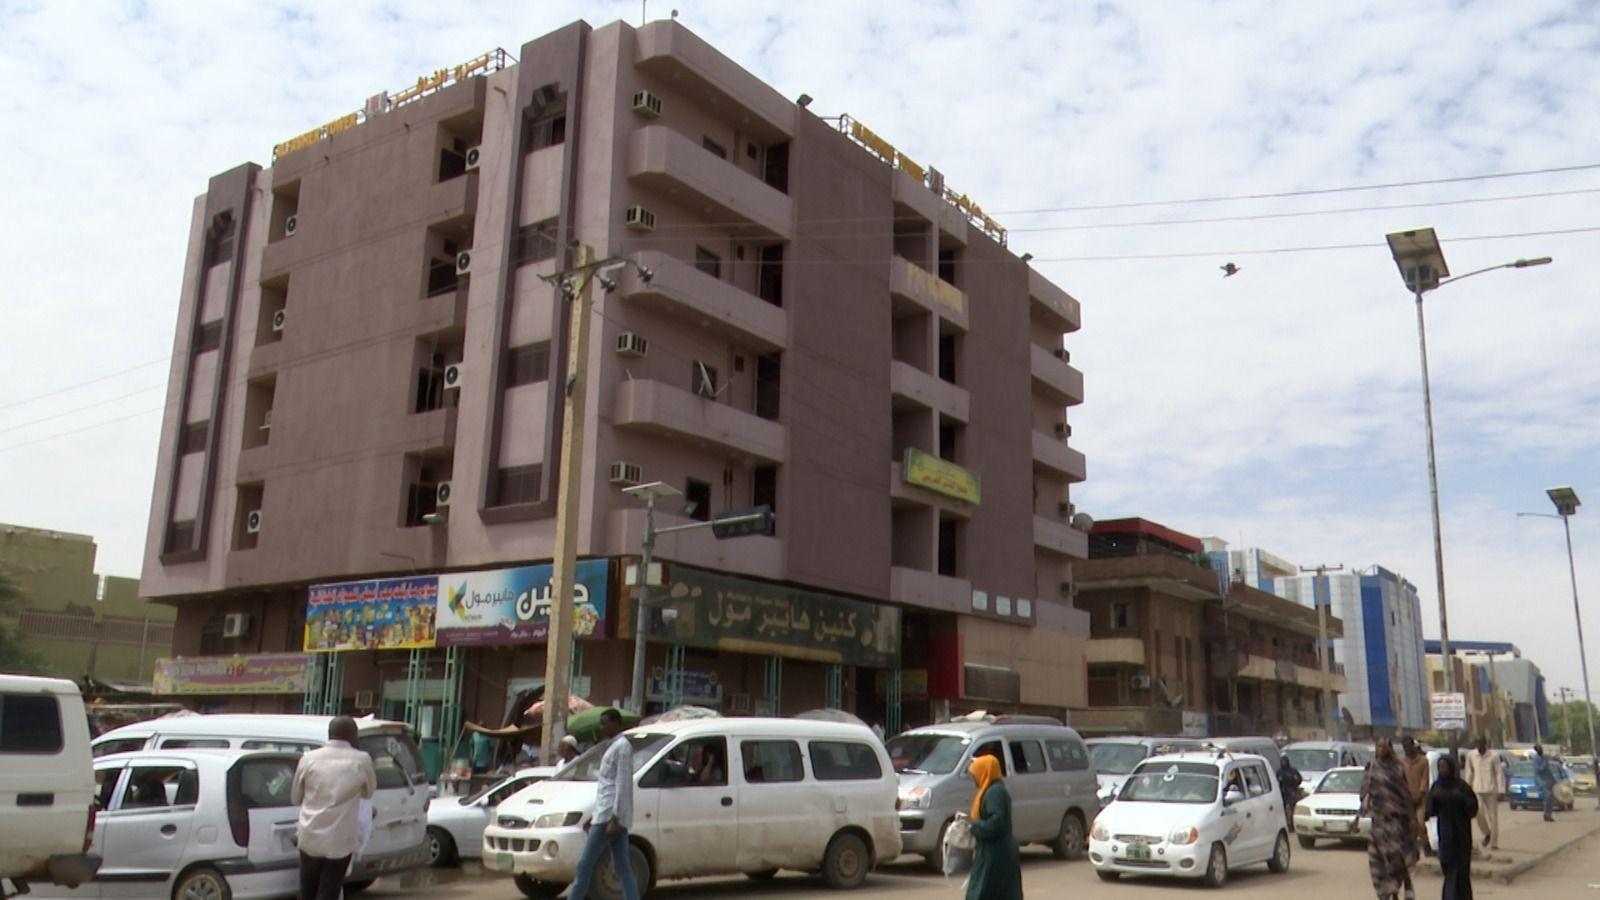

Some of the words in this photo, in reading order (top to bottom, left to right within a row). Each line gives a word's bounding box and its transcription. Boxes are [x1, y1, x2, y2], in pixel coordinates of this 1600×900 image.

[708, 591, 751, 627] مول
[756, 604, 810, 637] هايبر
[814, 608, 857, 642] كنين
